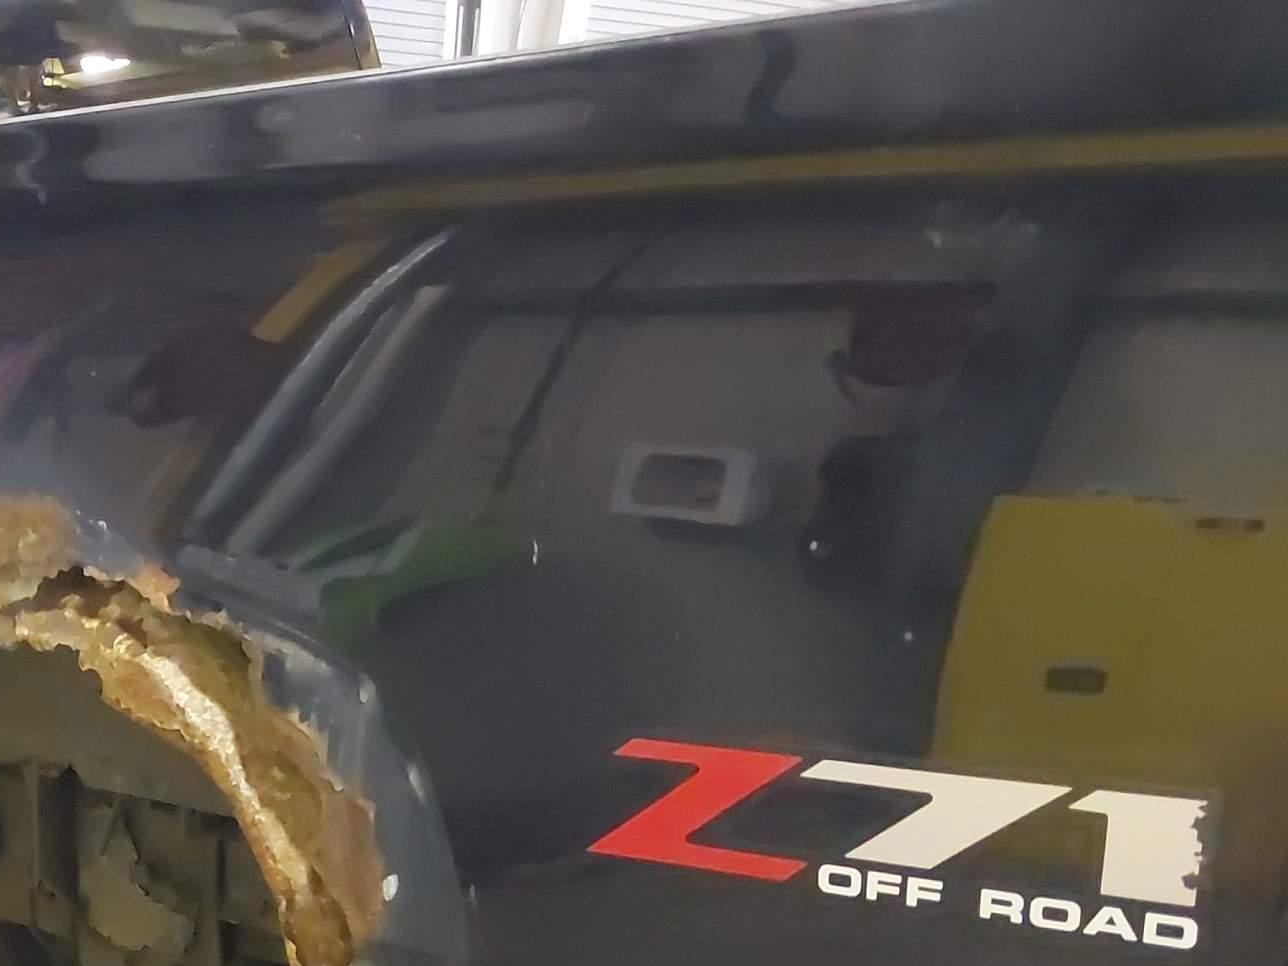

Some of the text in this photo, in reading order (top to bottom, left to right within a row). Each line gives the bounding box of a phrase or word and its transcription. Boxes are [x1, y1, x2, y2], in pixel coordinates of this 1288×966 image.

[587, 738, 1208, 907] Z71
[817, 863, 1199, 950] OFF ROAD
